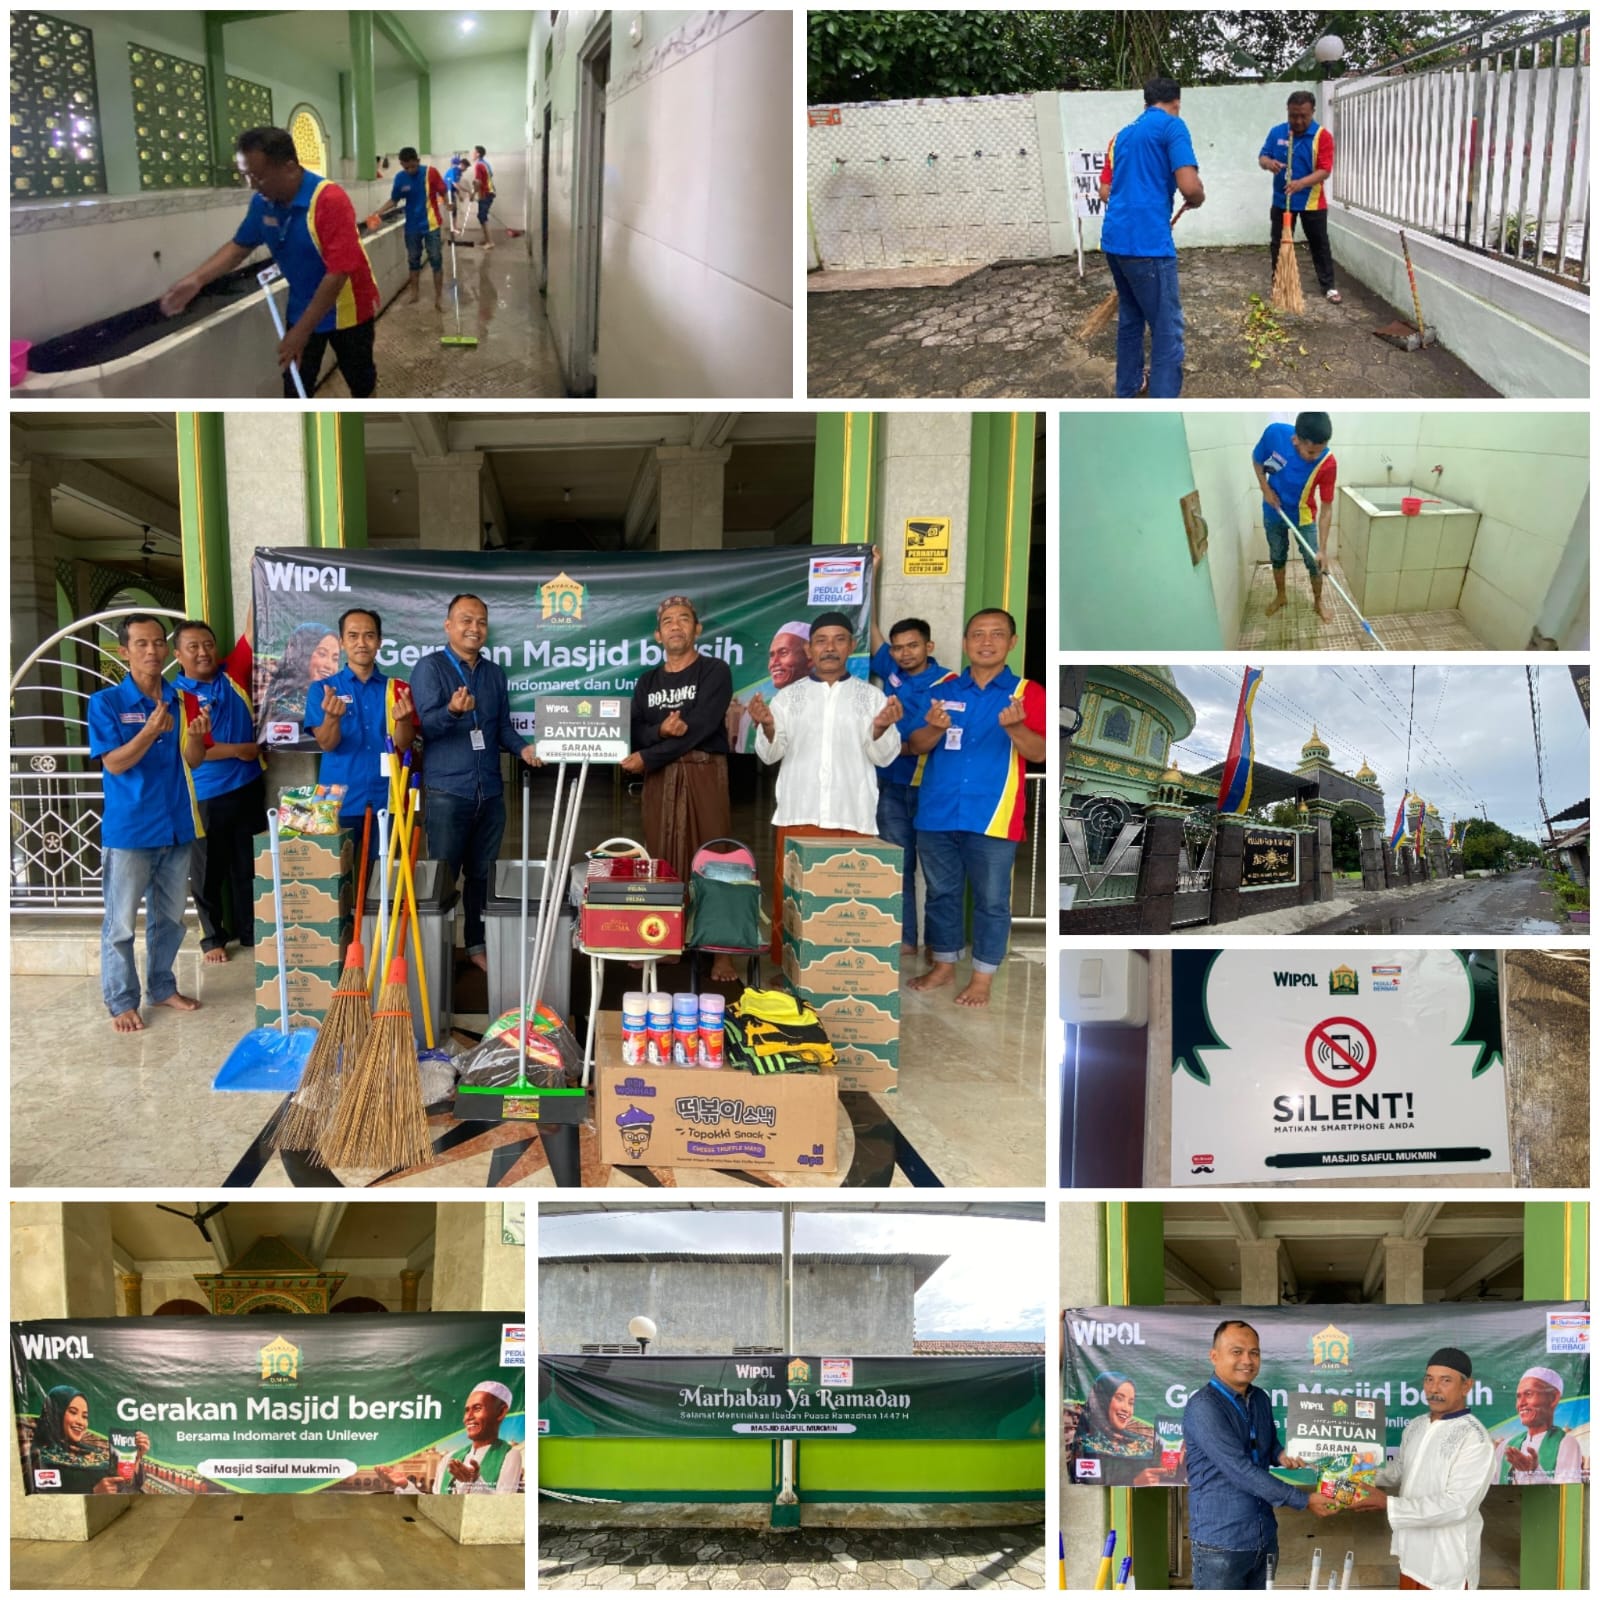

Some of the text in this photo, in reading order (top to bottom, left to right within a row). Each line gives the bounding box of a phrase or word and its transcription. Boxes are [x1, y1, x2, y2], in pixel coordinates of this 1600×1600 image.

[264, 561, 351, 592] WIPOL
[547, 591, 577, 616] 10
[813, 594, 852, 602] BERBAGI
[524, 639, 629, 671] Masjid
[507, 679, 579, 691] Indomaret
[584, 678, 610, 690] dan
[546, 704, 569, 713] WIPOL
[544, 726, 620, 738] BANTUAN
[1274, 972, 1319, 986] WIPOL
[1273, 1093, 1414, 1122] SILENT!
[688, 1128, 764, 1140] Topokki Snack
[1274, 1125, 1317, 1133] MATIKAN
[1321, 1123, 1385, 1131] SMARTPHONE
[1322, 1152, 1437, 1163] MASJID SAIFUL MUKMIN
[1072, 1321, 1146, 1345] WIPOL
[20, 1334, 94, 1360] WIPOL
[736, 1365, 775, 1378] WIPOL
[678, 1385, 911, 1412] Marhaban Ya Ramadan
[117, 1394, 442, 1424] Gerakan Masjid bersih
[176, 1430, 379, 1441] Bersama Indomaret dan Unilever
[1297, 1424, 1376, 1440] BANTUAN
[1316, 1443, 1358, 1452] SARANA
[214, 1464, 340, 1476] Masjid Saiful Mukmin
